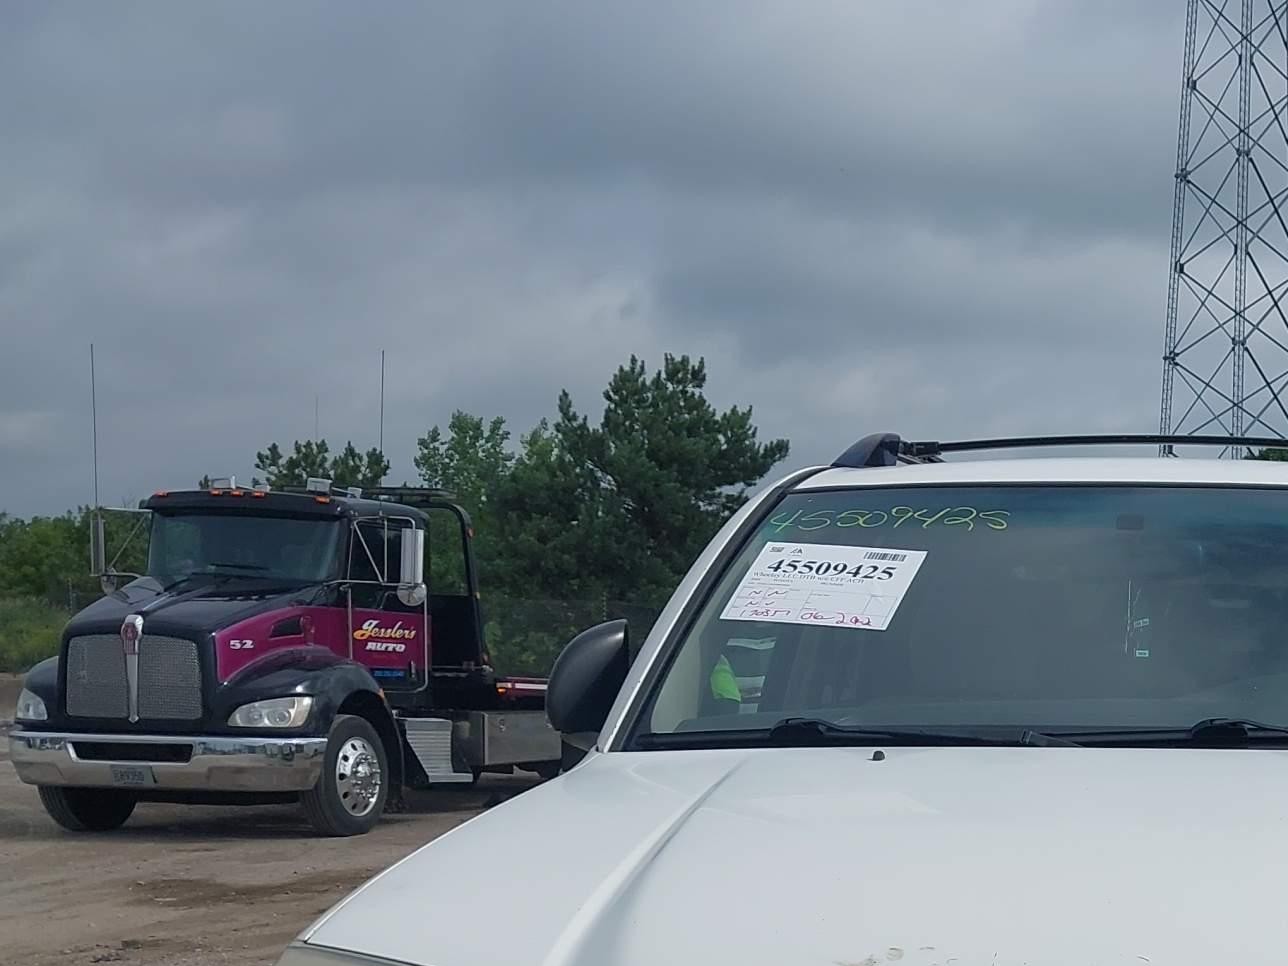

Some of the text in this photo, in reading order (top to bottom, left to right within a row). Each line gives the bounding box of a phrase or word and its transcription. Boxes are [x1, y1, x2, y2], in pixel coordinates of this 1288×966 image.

[770, 506, 1010, 534] 45509425
[767, 559, 897, 581] 45509425
[230, 639, 254, 650] 52
[365, 641, 406, 652] AUTO
